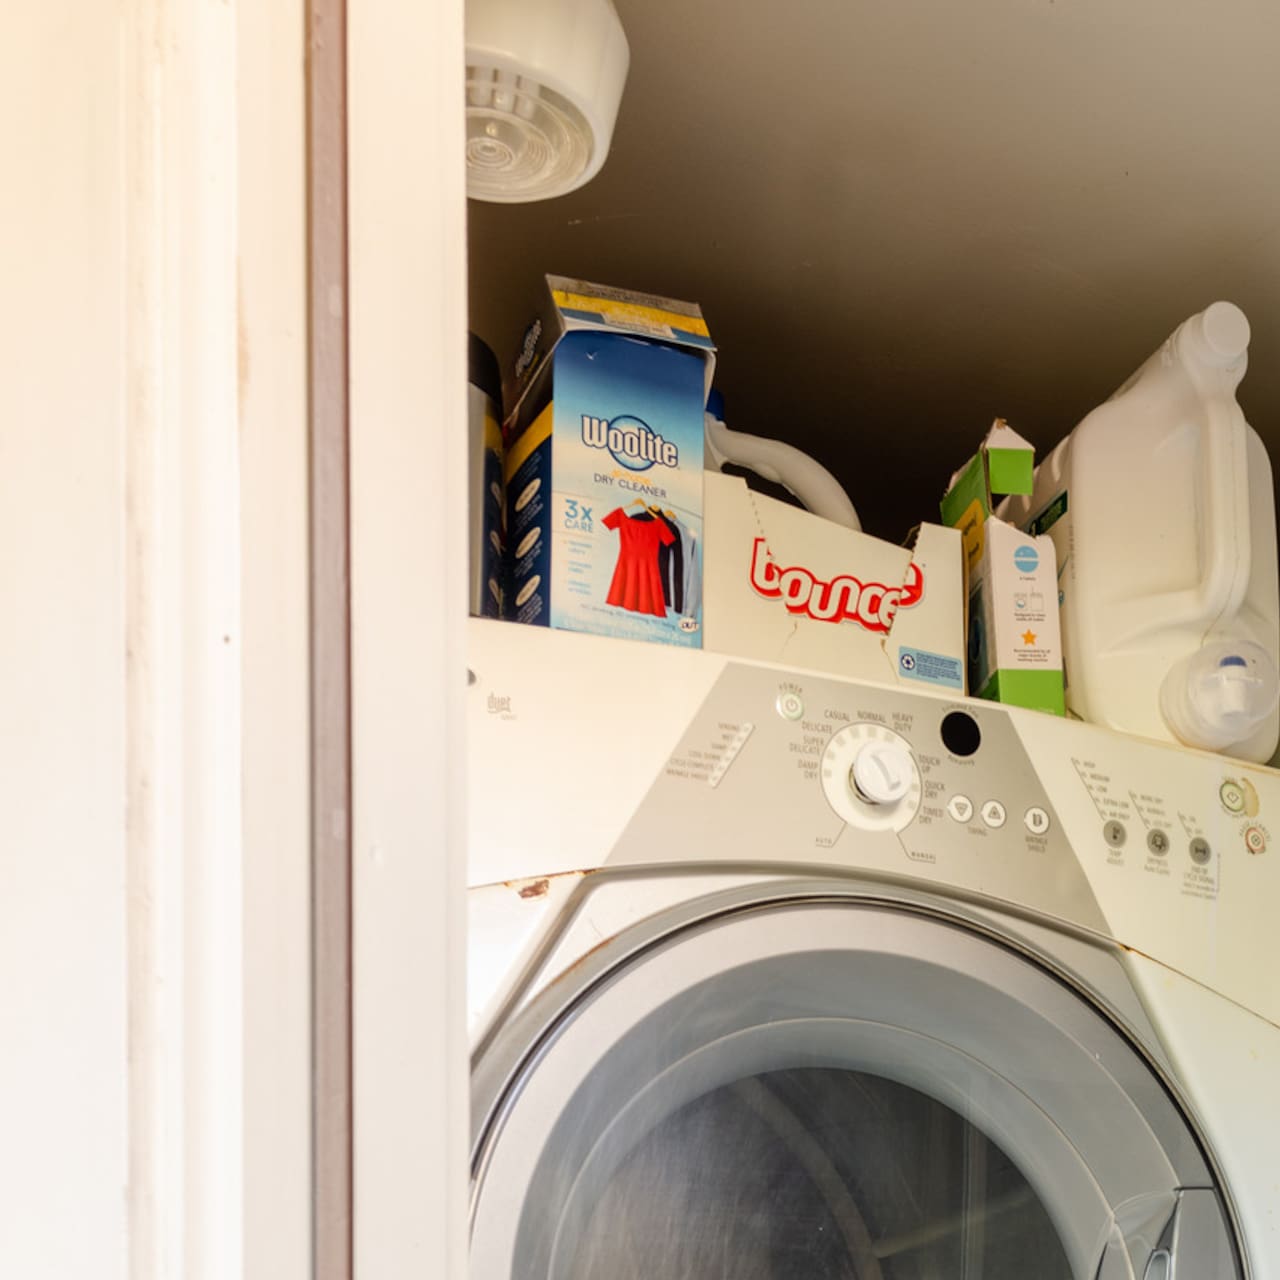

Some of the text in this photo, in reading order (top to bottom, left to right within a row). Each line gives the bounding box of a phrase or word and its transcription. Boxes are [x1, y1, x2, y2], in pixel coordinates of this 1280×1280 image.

[581, 414, 678, 467] Woolite
[594, 473, 615, 486] DRY
[619, 479, 667, 498] CLEANER
[564, 519, 594, 532] CARE
[824, 709, 851, 722] CASUAL
[857, 710, 887, 724] NORMAL
[892, 712, 913, 723] HEAVY
[801, 720, 833, 734] DELICATE
[894, 722, 912, 732] DUTY
[803, 735, 825, 746] SUPER
[789, 743, 821, 754] DELICATE
[797, 759, 819, 769] DAMP
[918, 754, 941, 766] TOUCH
[804, 770, 818, 780] DRY
[925, 780, 945, 791] QUICK
[924, 789, 938, 799] DRY
[923, 806, 944, 818] TIMED
[919, 816, 932, 825] DRY
